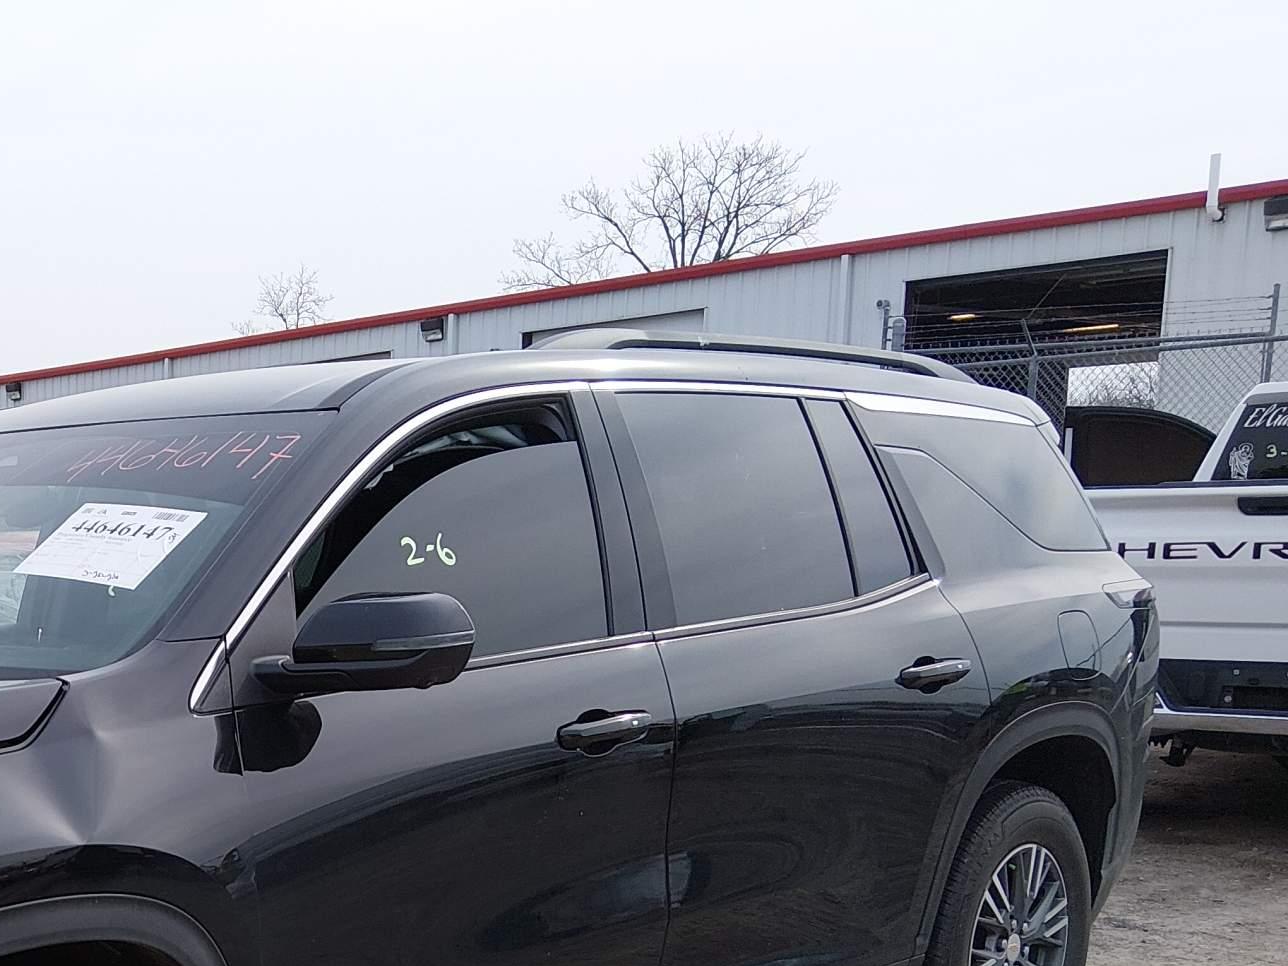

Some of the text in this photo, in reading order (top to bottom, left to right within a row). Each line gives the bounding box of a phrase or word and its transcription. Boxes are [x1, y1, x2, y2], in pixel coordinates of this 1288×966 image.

[67, 431, 301, 483] 44646147
[71, 519, 176, 542] 44646147
[400, 532, 457, 566] 2-6
